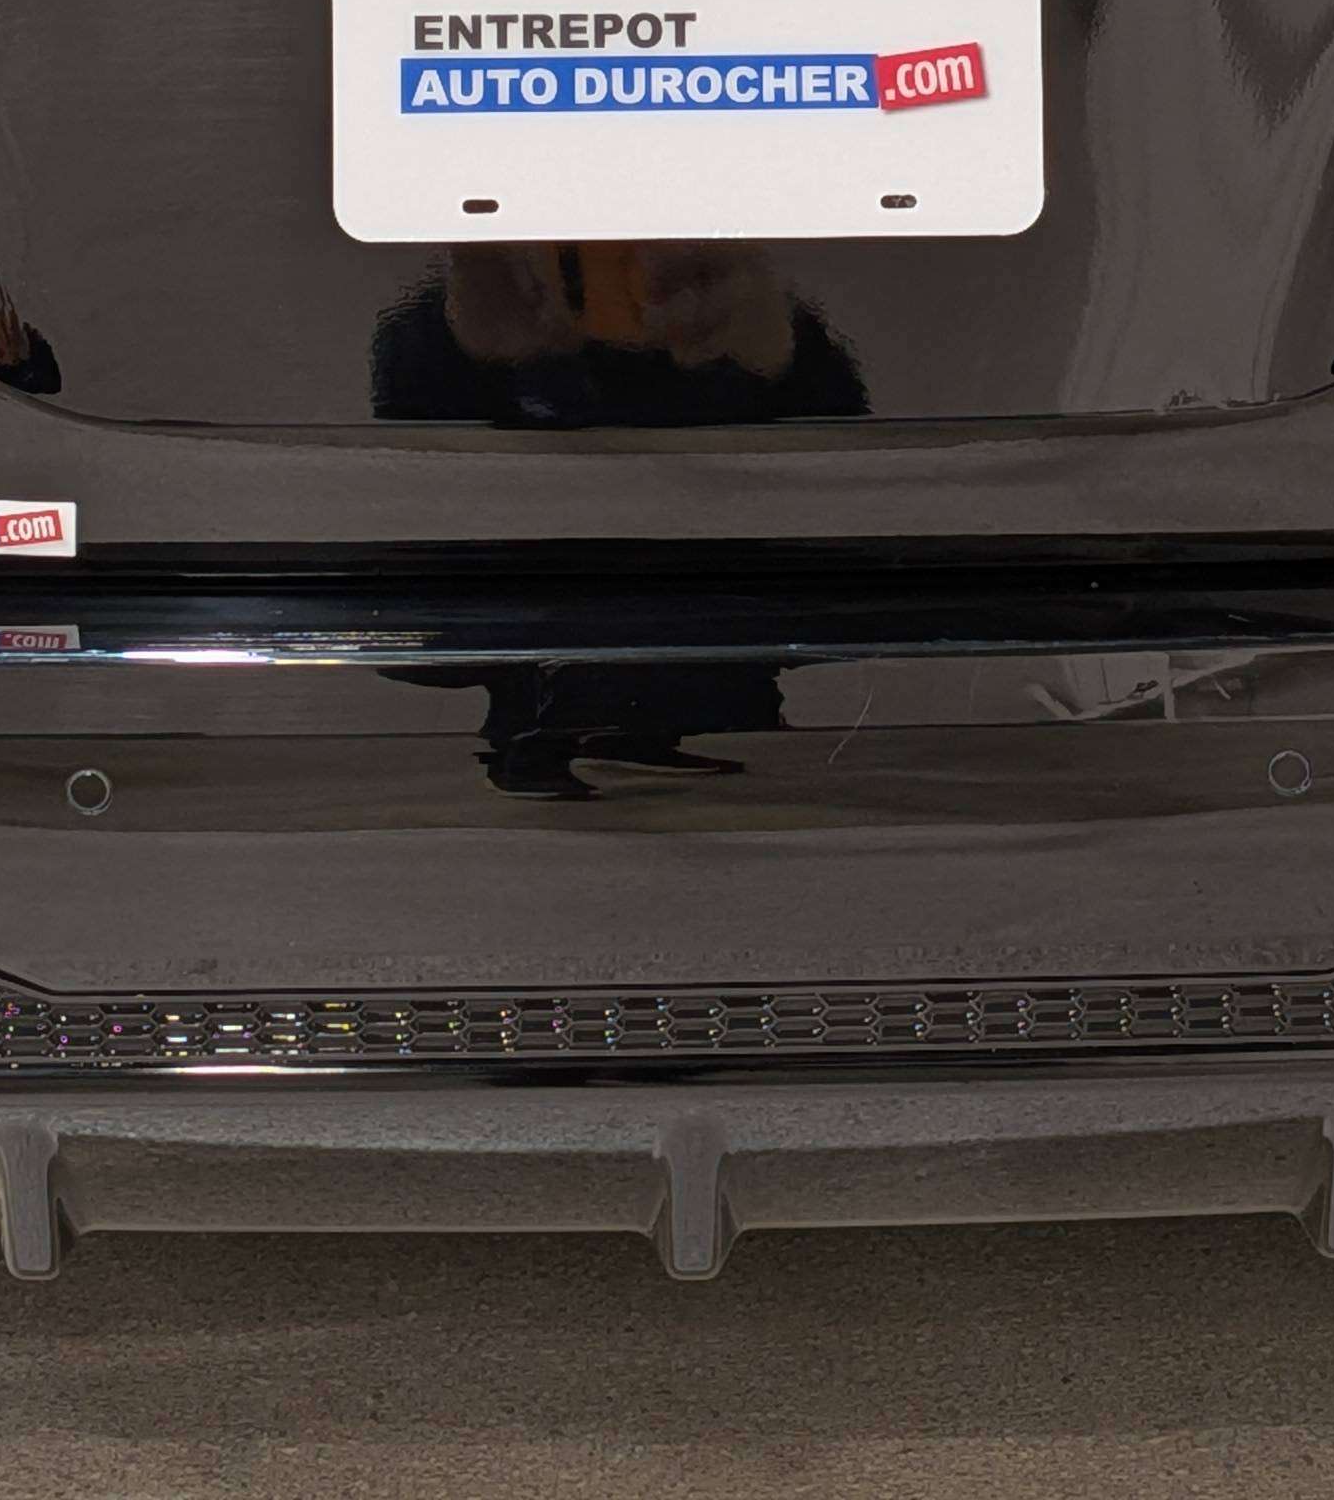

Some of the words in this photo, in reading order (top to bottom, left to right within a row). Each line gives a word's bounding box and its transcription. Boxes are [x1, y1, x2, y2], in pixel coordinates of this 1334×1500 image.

[413, 11, 698, 51] ENTREPOT
[411, 67, 558, 107] AUTO
[574, 63, 870, 105] DUROCHER
[884, 55, 975, 101] .com
[0, 514, 56, 543] .com
